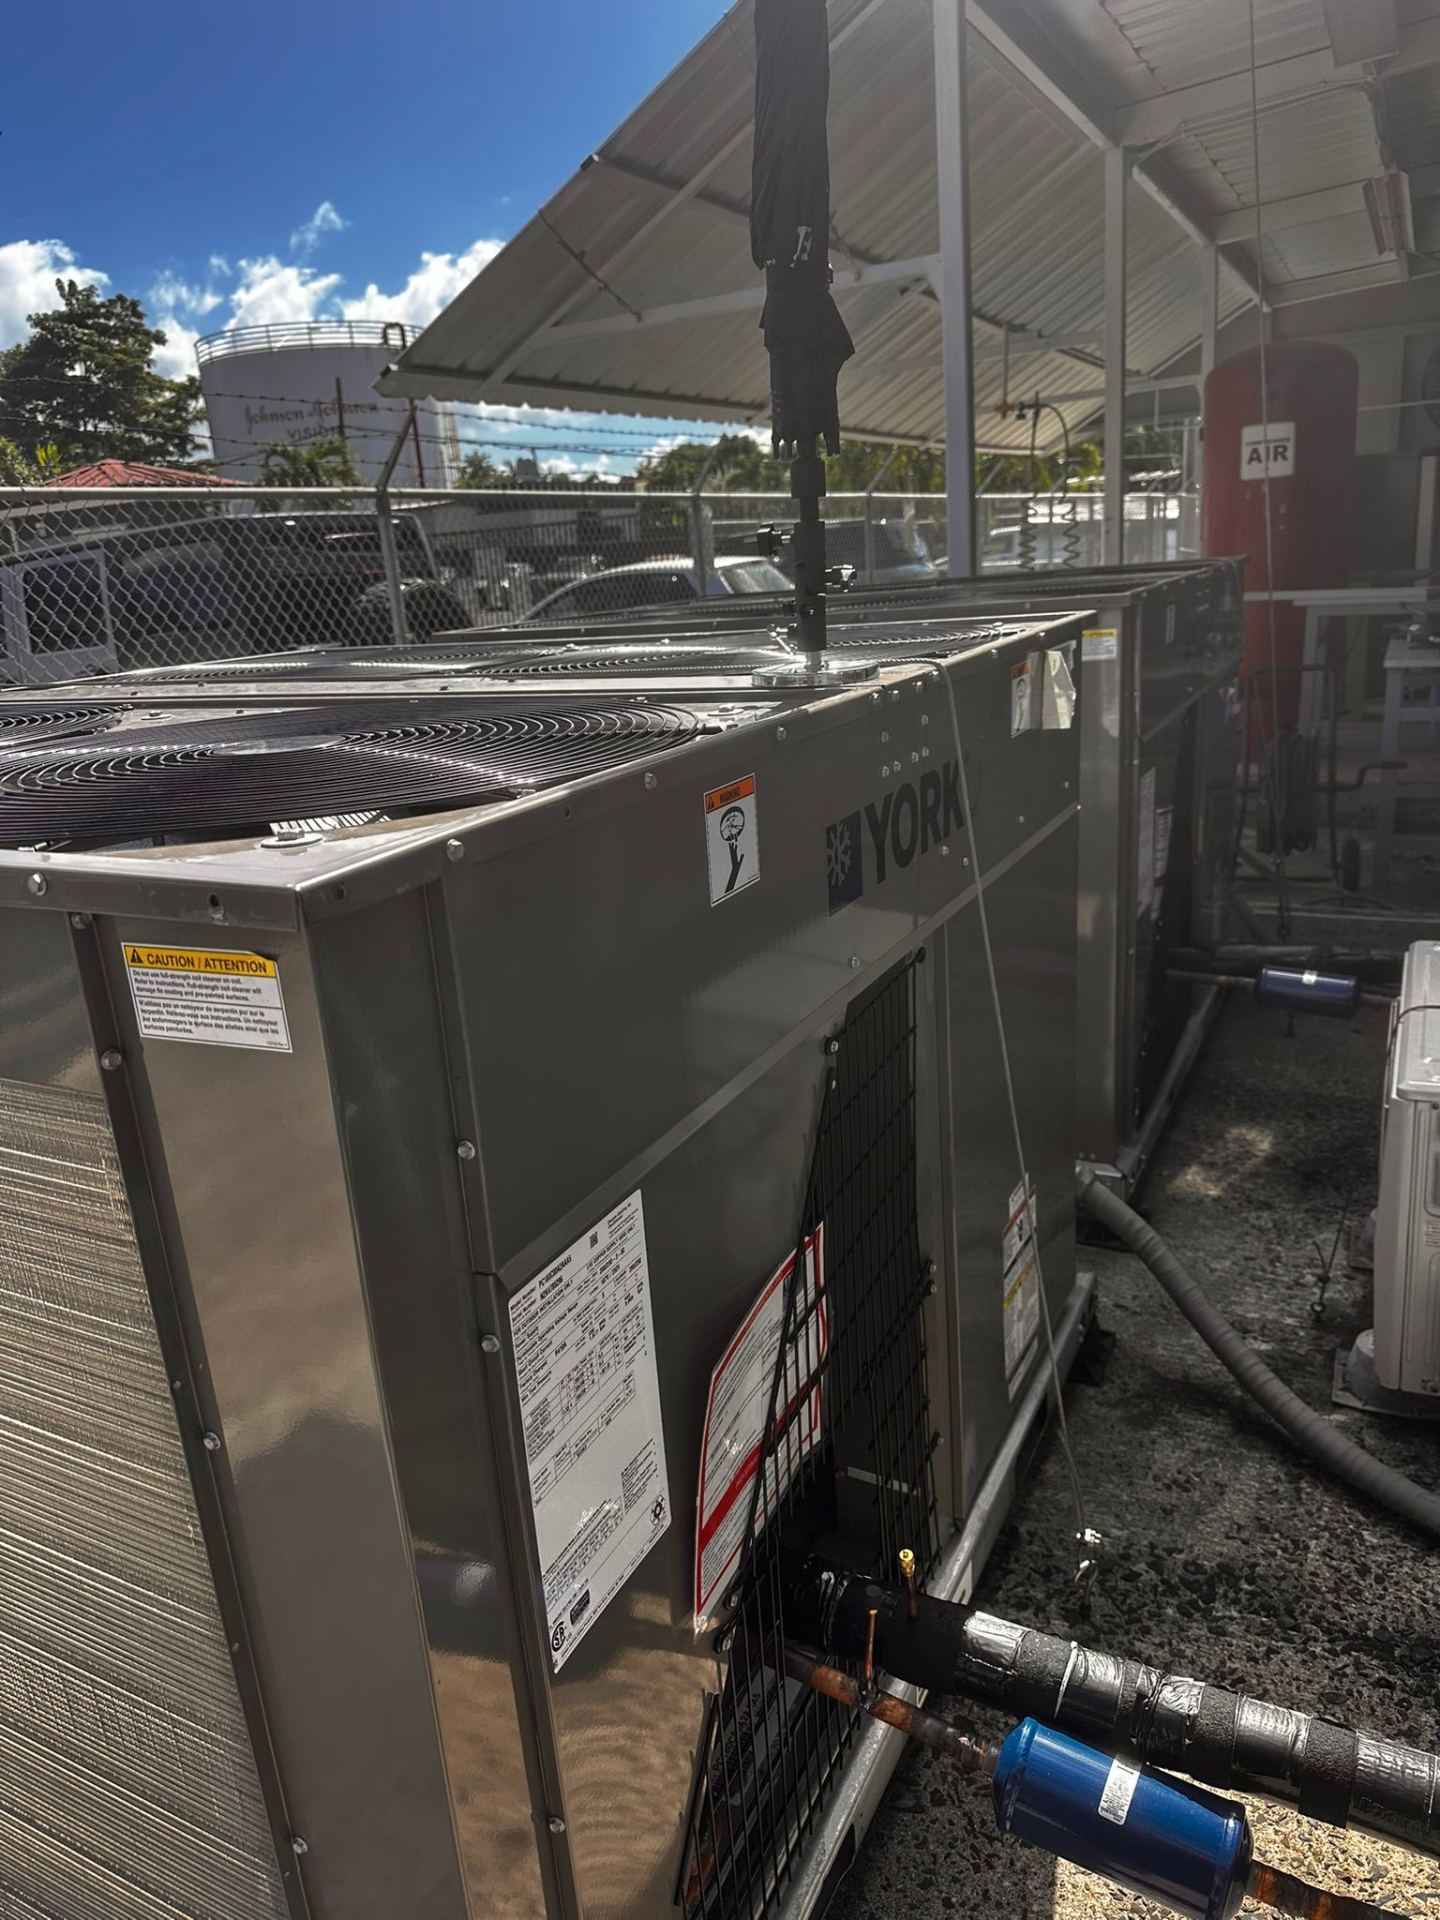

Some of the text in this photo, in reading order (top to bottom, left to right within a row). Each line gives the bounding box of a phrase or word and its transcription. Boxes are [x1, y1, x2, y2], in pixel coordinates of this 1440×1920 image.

[1247, 444, 1288, 465] AIR
[863, 757, 967, 884] YORK
[147, 953, 195, 969] CAUTION
[204, 958, 267, 974] ATTENTION
